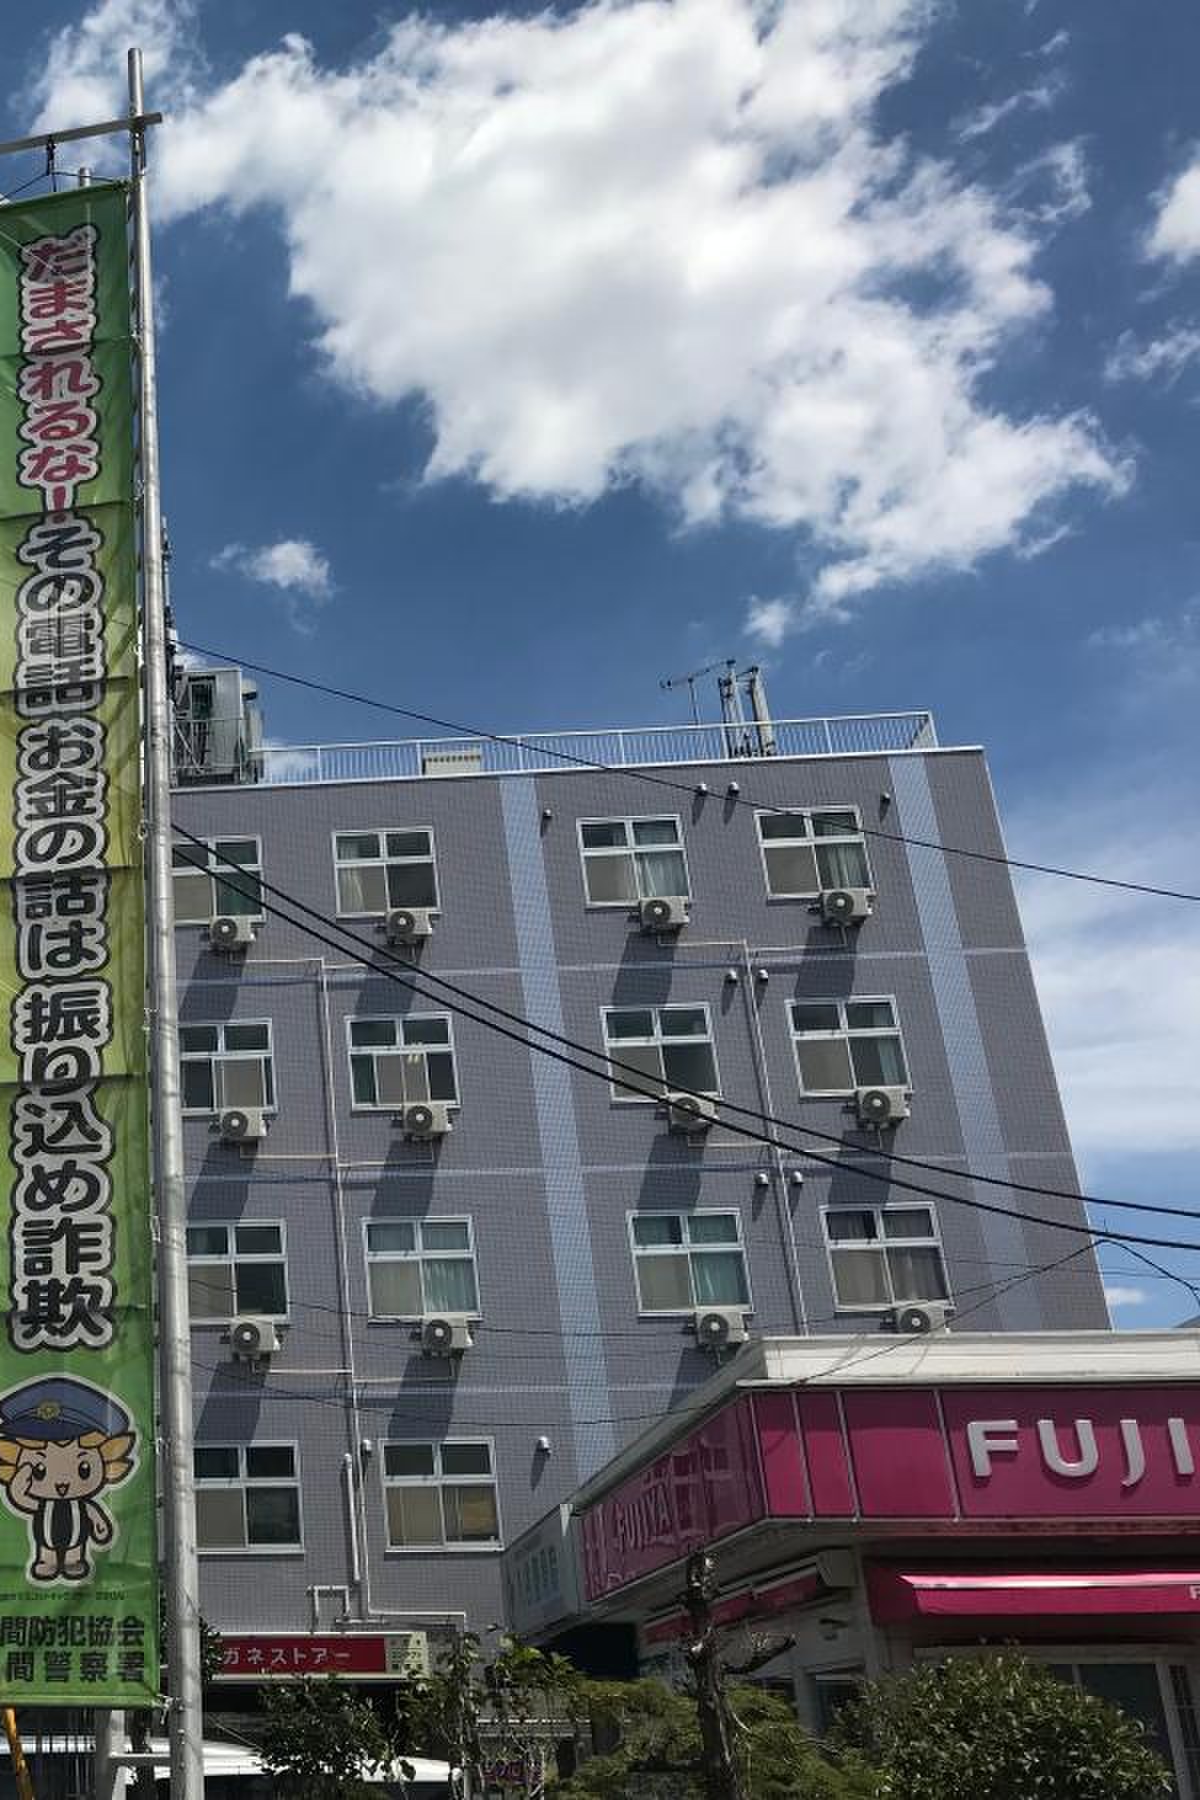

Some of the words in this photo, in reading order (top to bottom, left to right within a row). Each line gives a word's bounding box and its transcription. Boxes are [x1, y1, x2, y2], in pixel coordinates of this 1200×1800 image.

[967, 1418, 1195, 1486] FUJI
[223, 1647, 350, 1665] ガネストアー
